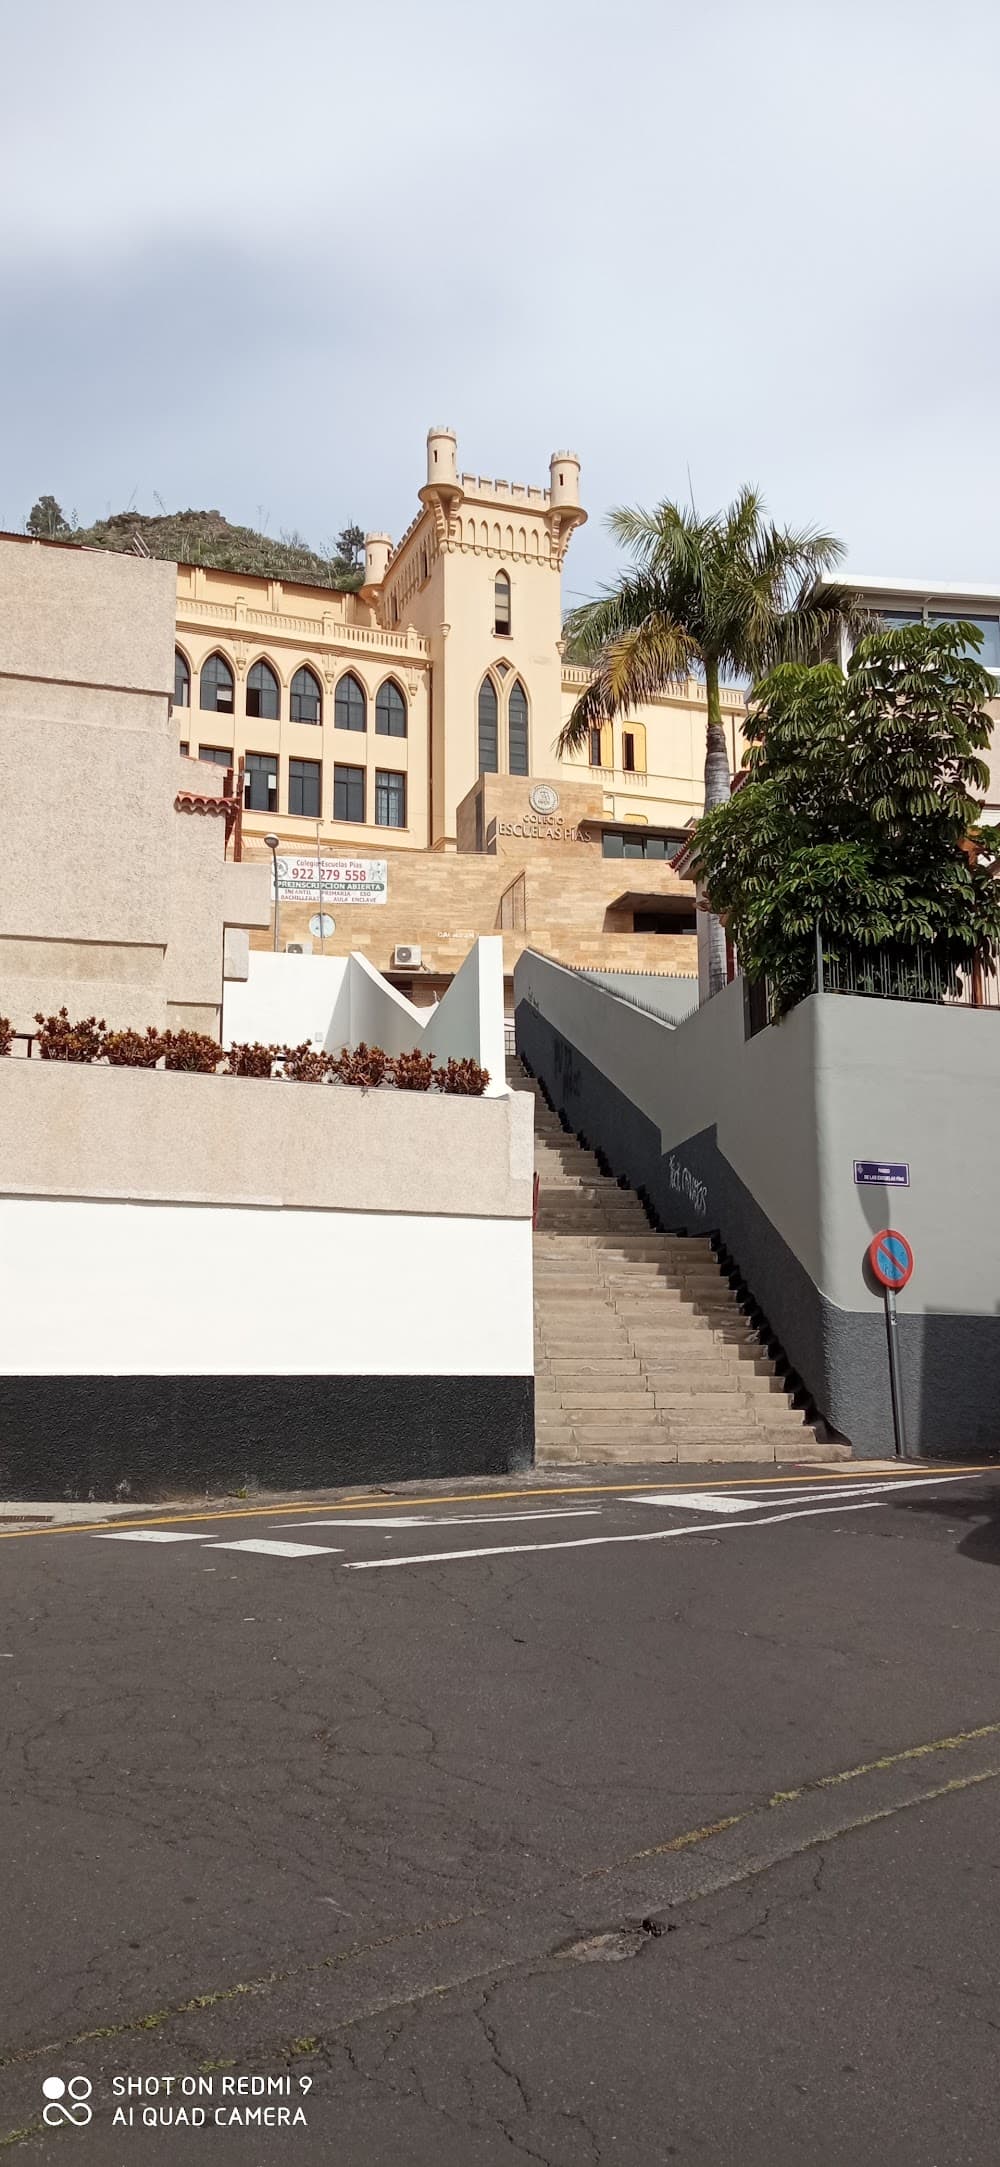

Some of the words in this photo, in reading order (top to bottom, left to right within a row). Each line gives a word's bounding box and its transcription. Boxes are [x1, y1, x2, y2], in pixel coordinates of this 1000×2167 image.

[522, 814, 565, 826] COLEGIO
[498, 823, 561, 841] ESCUELAS
[292, 868, 314, 880] 922
[320, 869, 340, 881] 279
[345, 870, 366, 881] 558
